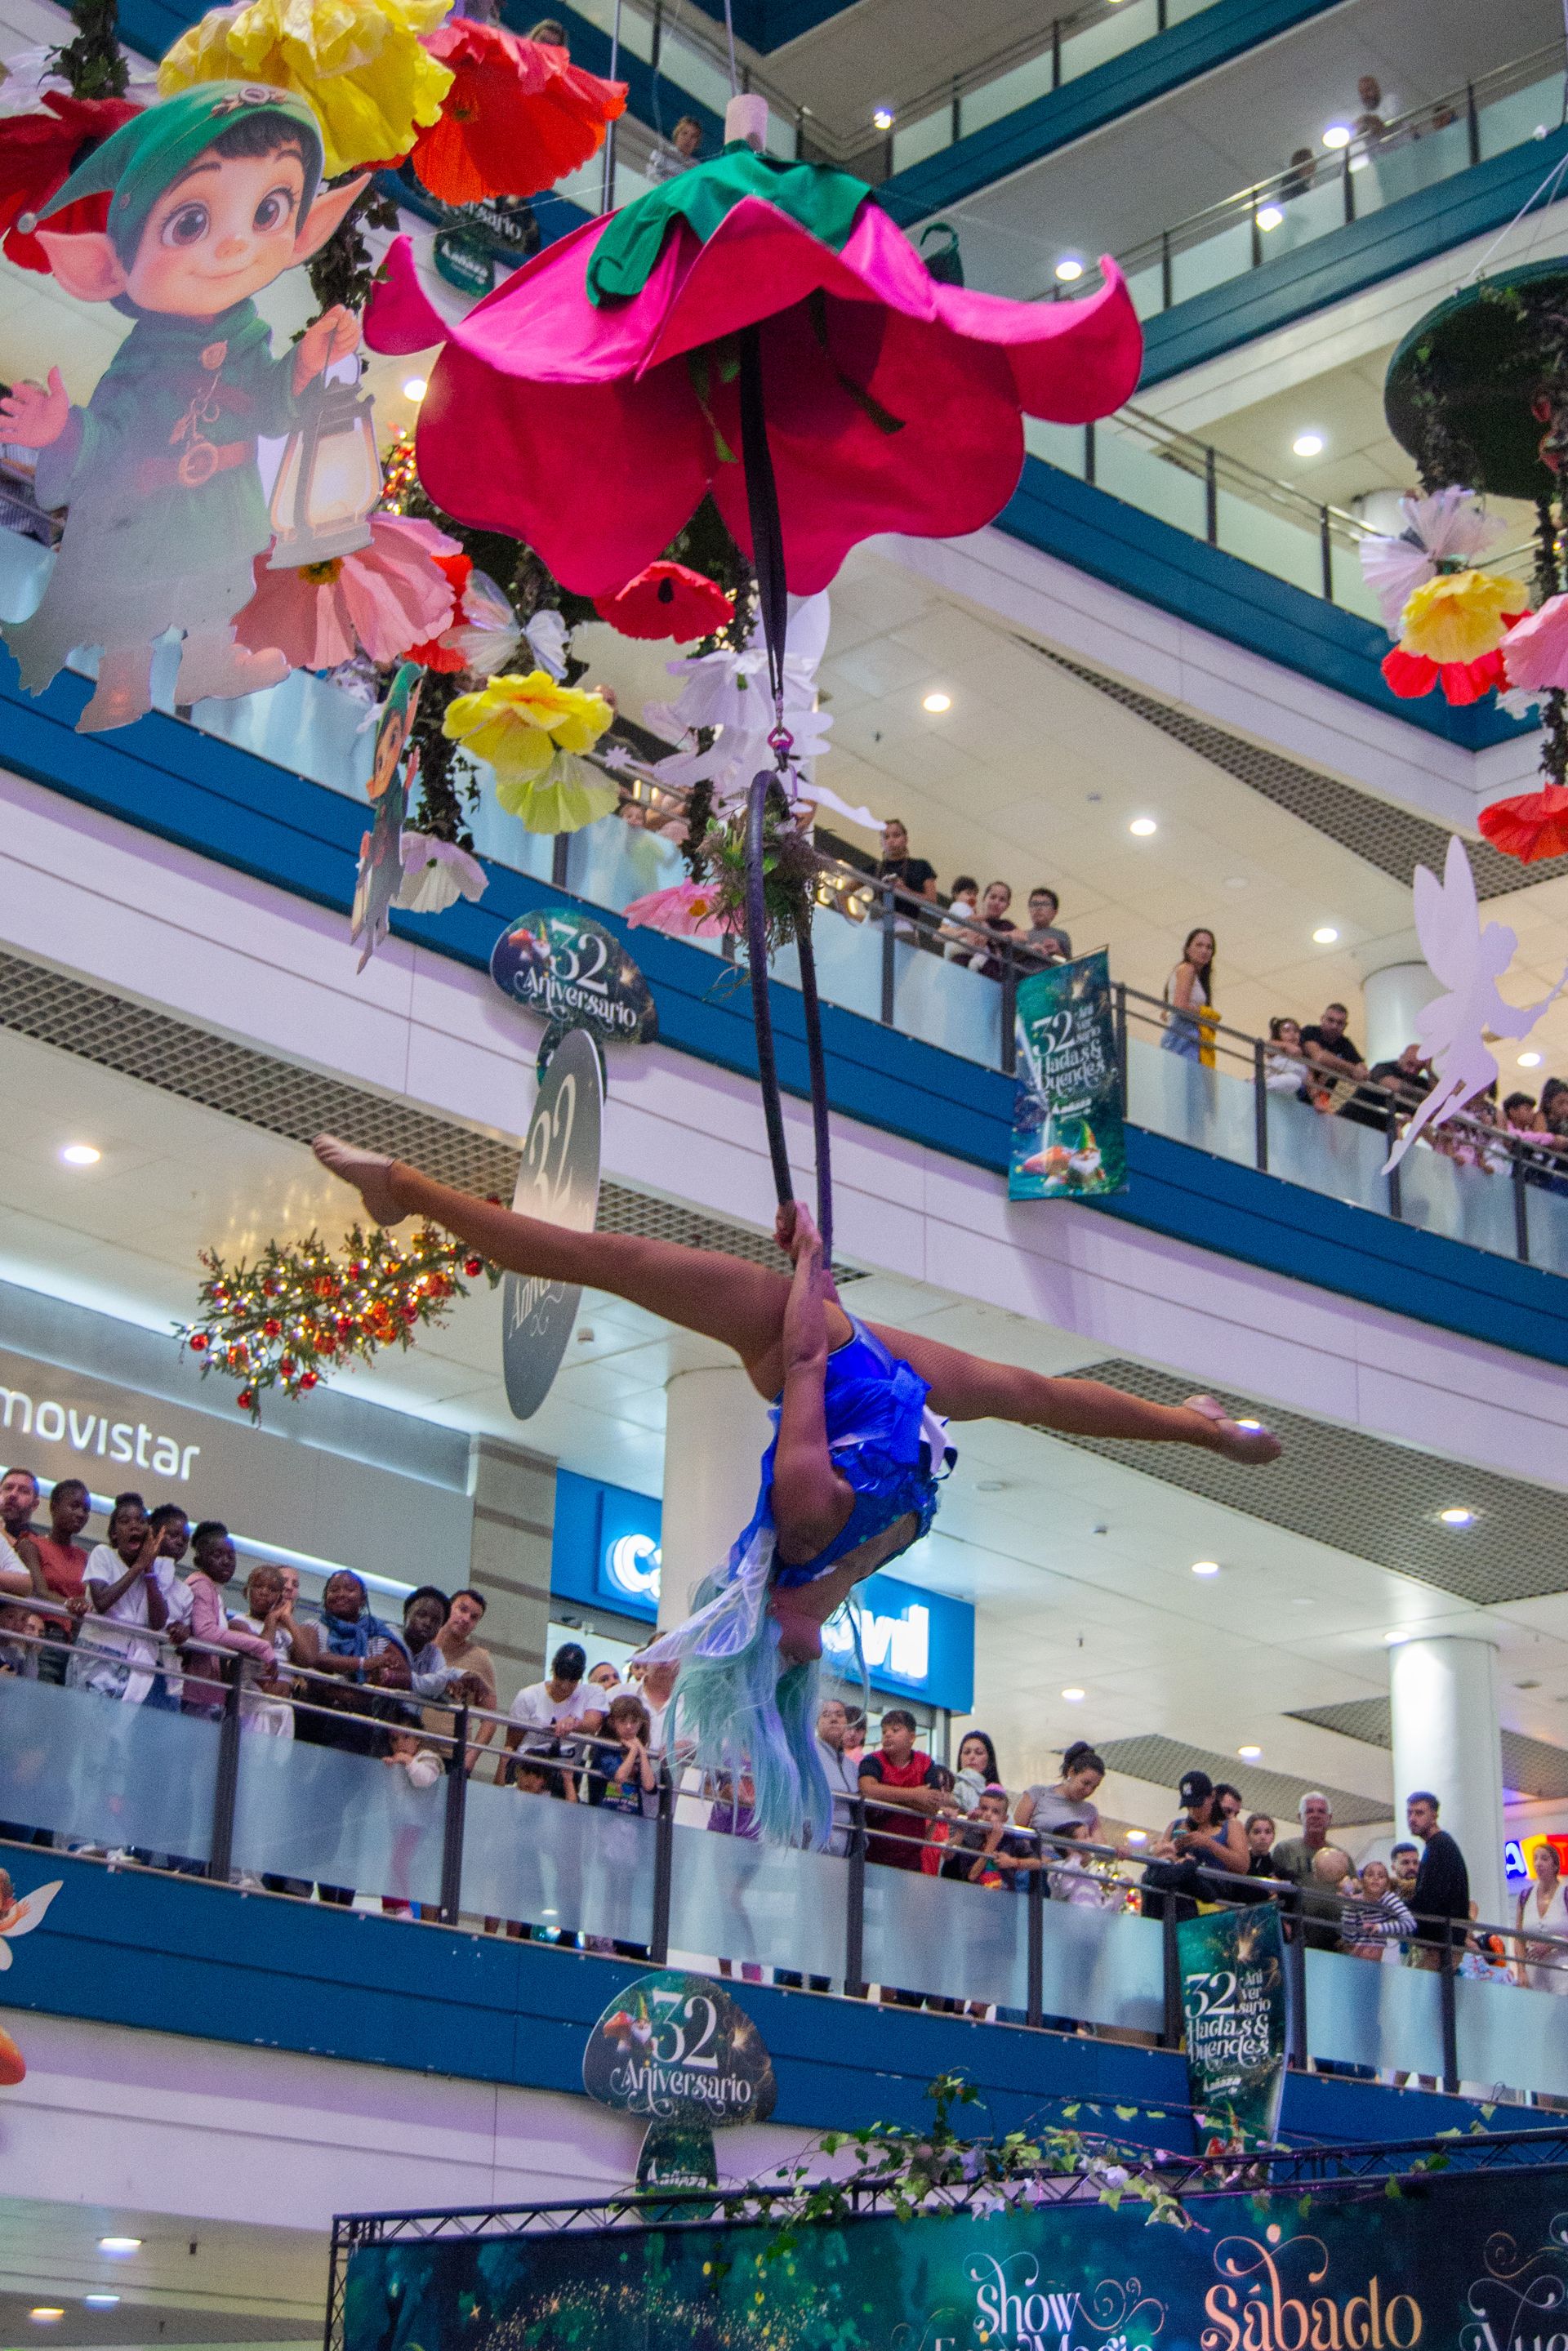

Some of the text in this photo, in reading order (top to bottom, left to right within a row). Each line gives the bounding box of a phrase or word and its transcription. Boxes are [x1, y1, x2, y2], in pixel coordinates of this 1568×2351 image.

[550, 918, 609, 995] 32
[513, 966, 637, 1032] Aniversario
[1032, 1010, 1076, 1057] 32
[0, 1387, 201, 1481] movistar
[1185, 1970, 1237, 2019] 32
[651, 1988, 719, 2070] 32
[1187, 2014, 1269, 2041] Hadas &
[1187, 2036, 1270, 2068] Duendes
[609, 2058, 751, 2117] Aniversario
[963, 2252, 1080, 2335] Show
[1200, 2228, 1423, 2351] Sábado
